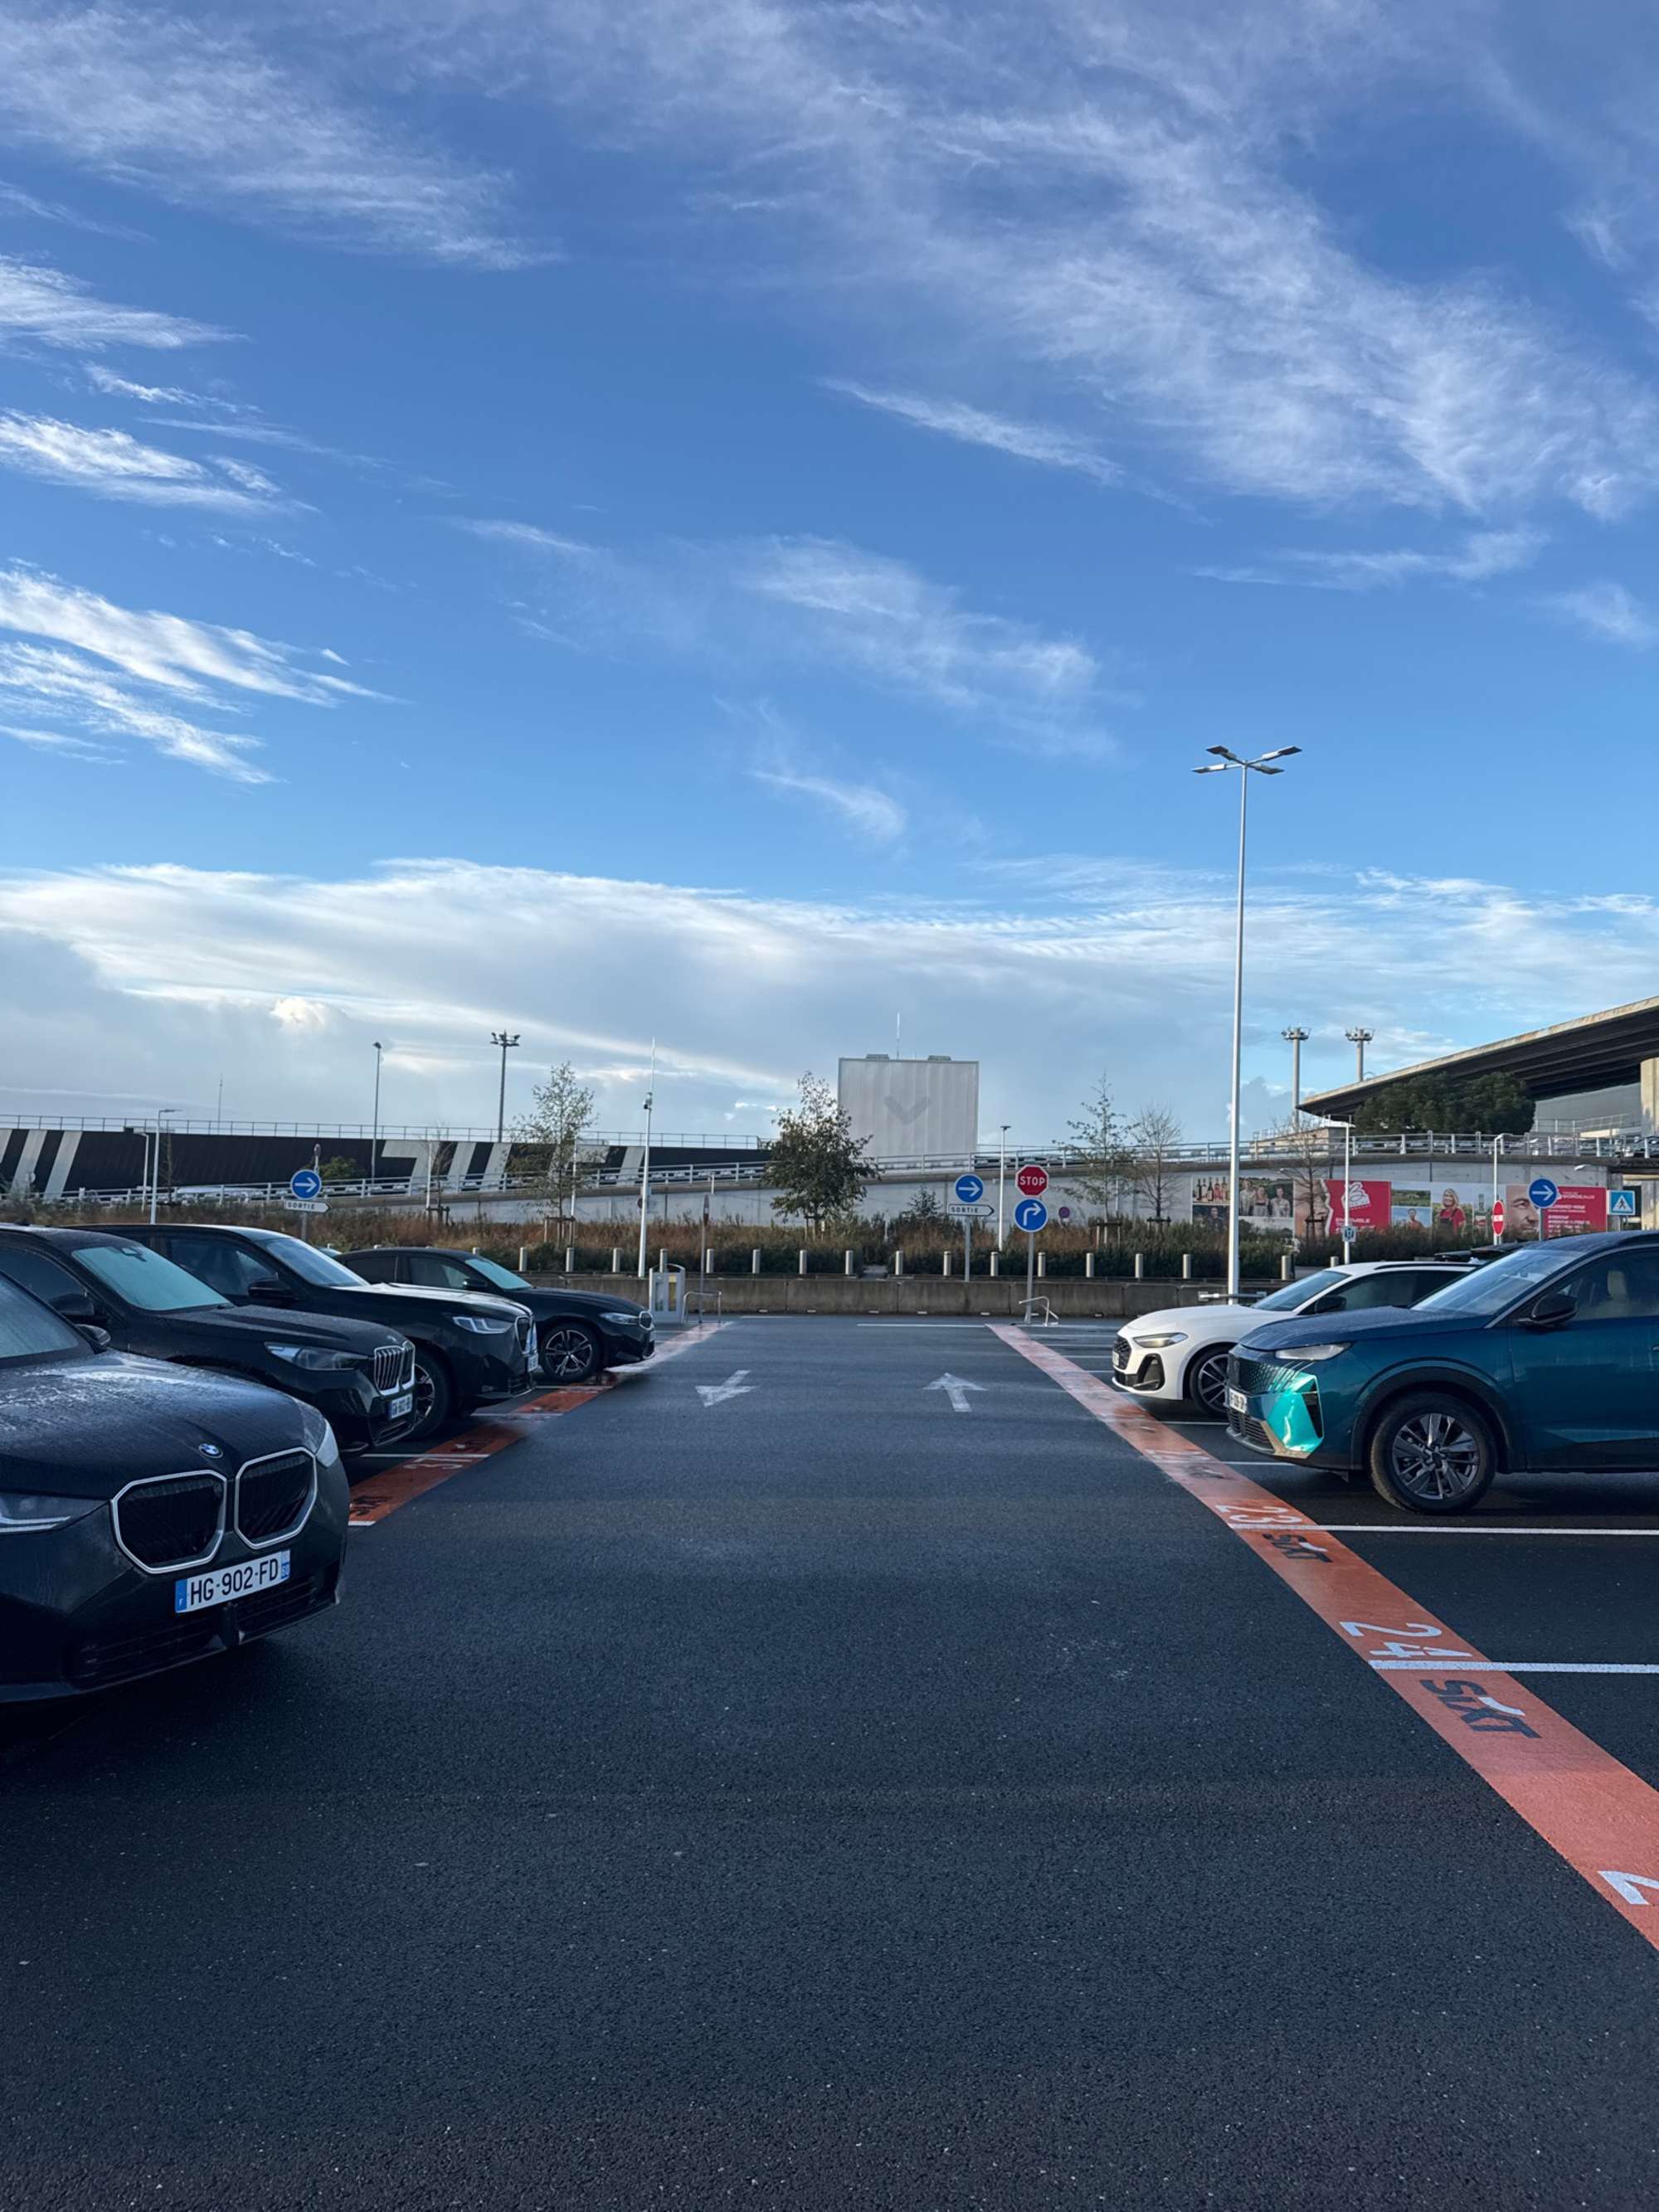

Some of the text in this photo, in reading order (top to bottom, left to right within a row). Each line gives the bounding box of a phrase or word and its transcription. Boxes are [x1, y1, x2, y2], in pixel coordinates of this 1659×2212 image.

[1019, 1176, 1045, 1186] STOP
[287, 1202, 315, 1210] SORTIE
[1215, 1504, 1302, 1524] 23
[1262, 1533, 1333, 1563] SIXT
[190, 1558, 279, 1607] HG-902-FD
[1339, 1621, 1473, 1658] 24
[1418, 1679, 1542, 1739] SIXT
